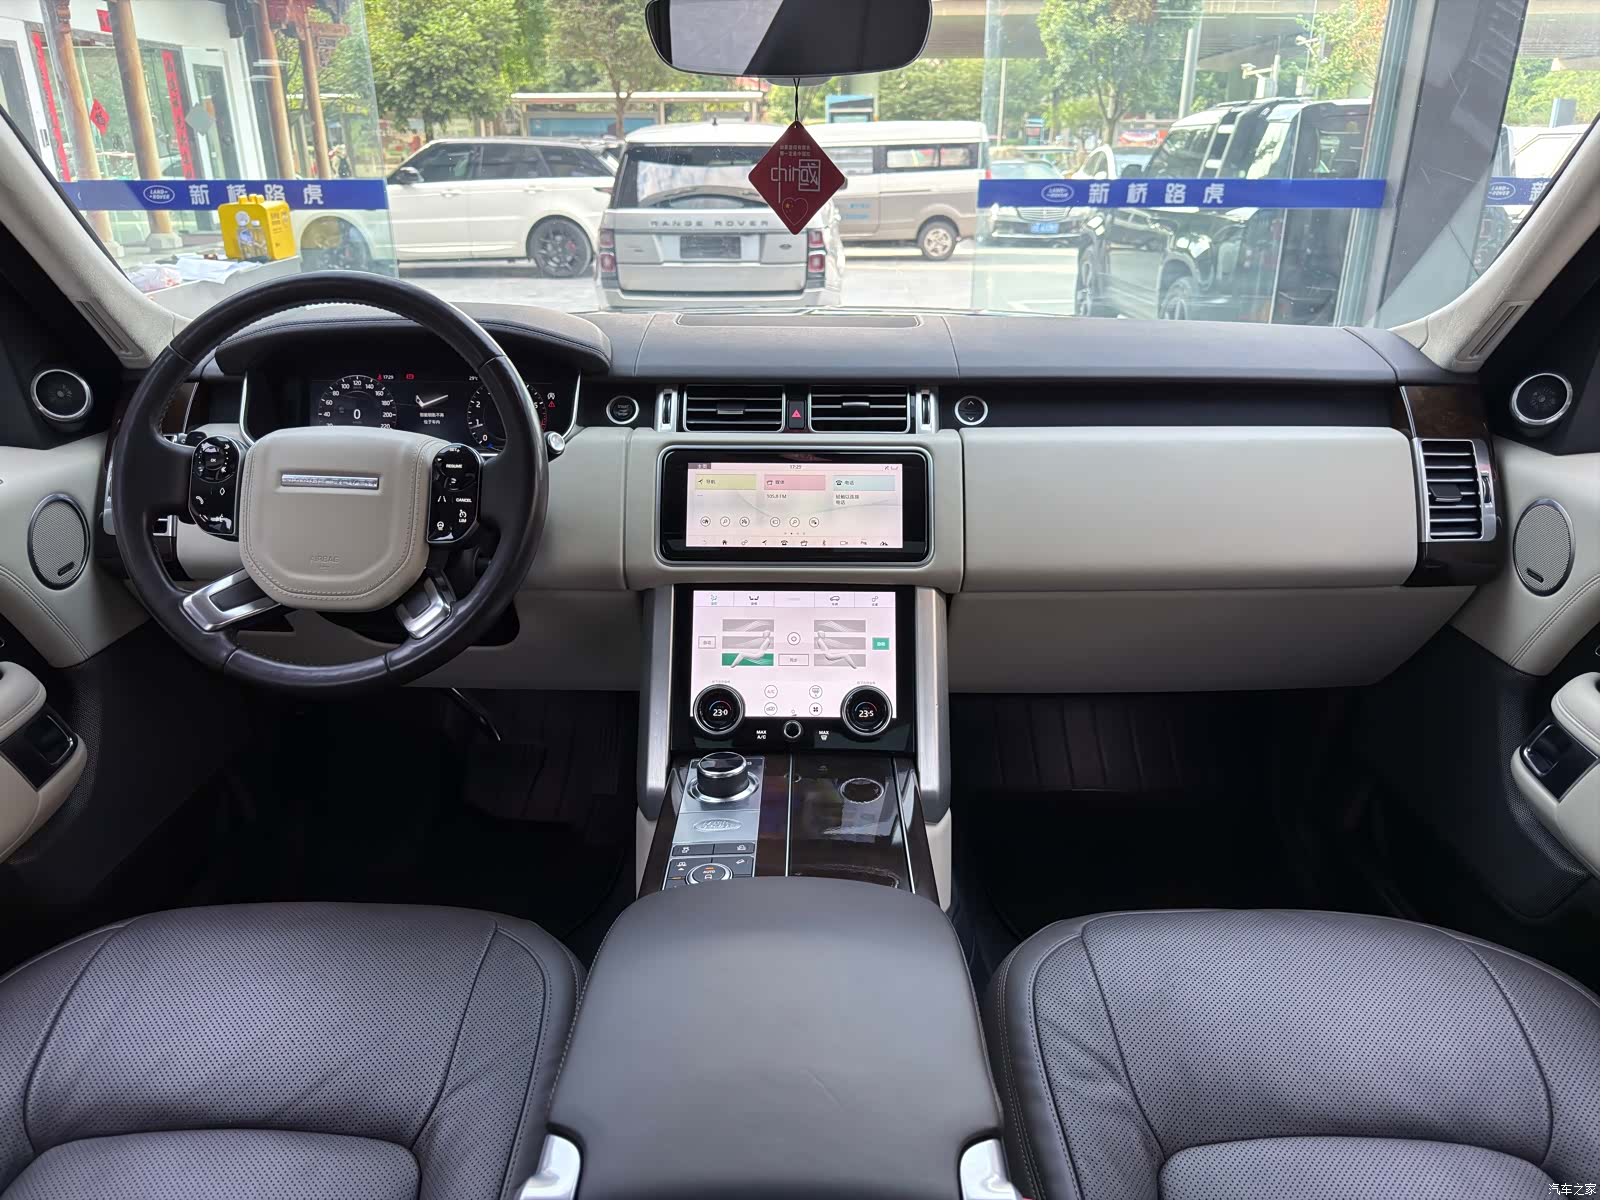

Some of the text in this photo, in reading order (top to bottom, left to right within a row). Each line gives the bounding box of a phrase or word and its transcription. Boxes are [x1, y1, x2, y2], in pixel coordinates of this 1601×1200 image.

[188, 183, 324, 205] 新桥路虎
[1088, 182, 1225, 204] 新桥路虎
[353, 408, 360, 420] 0
